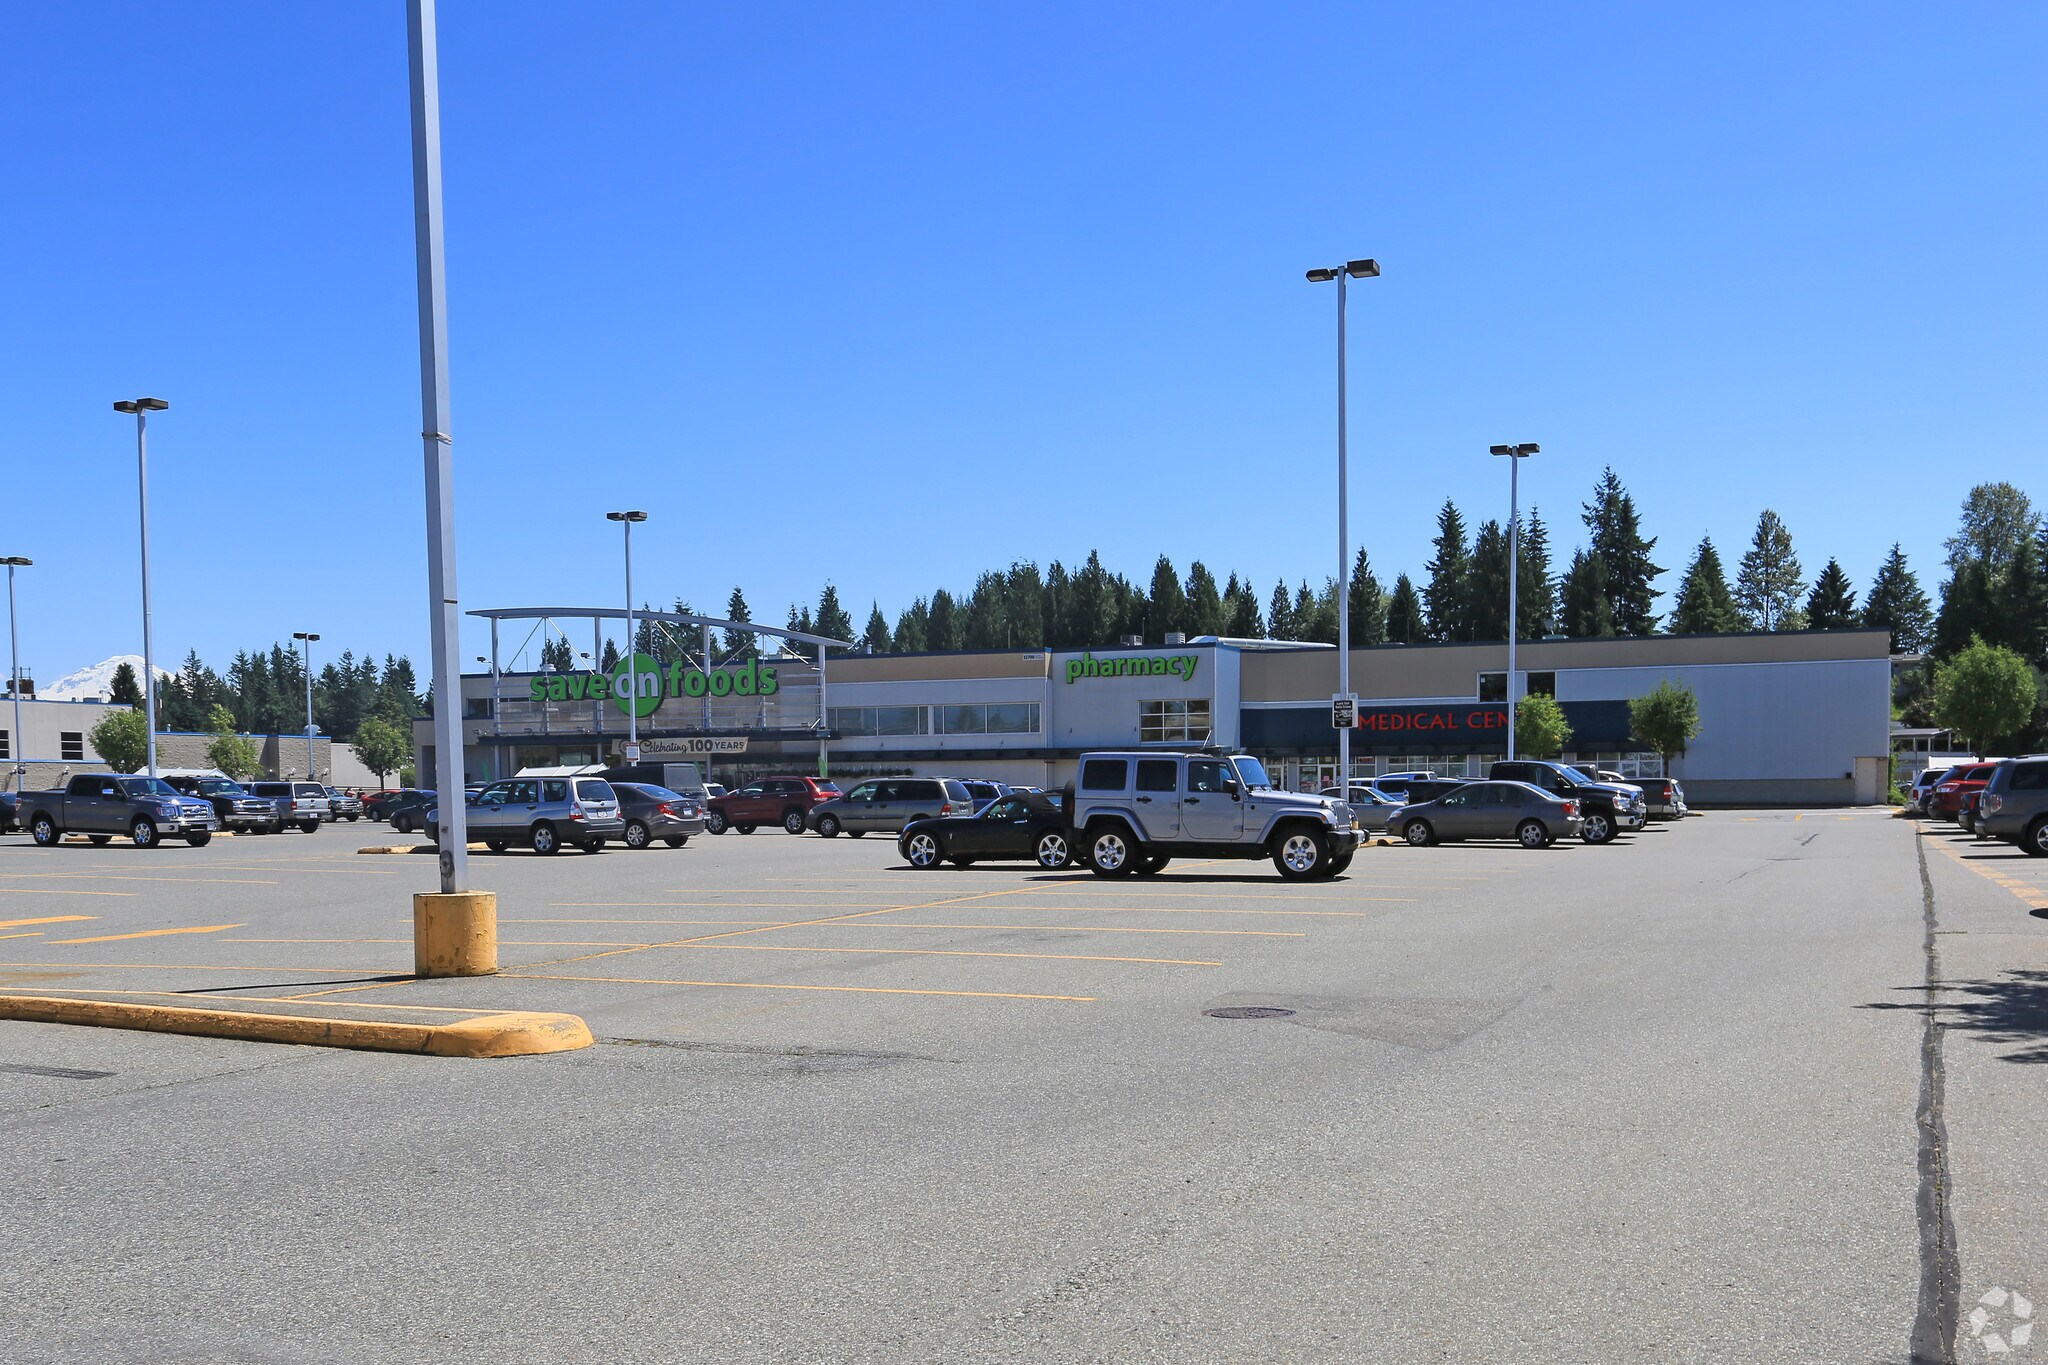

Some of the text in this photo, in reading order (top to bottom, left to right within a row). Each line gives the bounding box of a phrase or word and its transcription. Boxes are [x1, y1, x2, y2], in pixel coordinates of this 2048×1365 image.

[529, 658, 778, 702] save on foods
[1066, 651, 1198, 684] pharmacy
[1358, 711, 1511, 731] MEDICAL CEN
[639, 739, 688, 754] Celebrating
[688, 739, 713, 752] 100
[714, 741, 744, 750] YEARS
